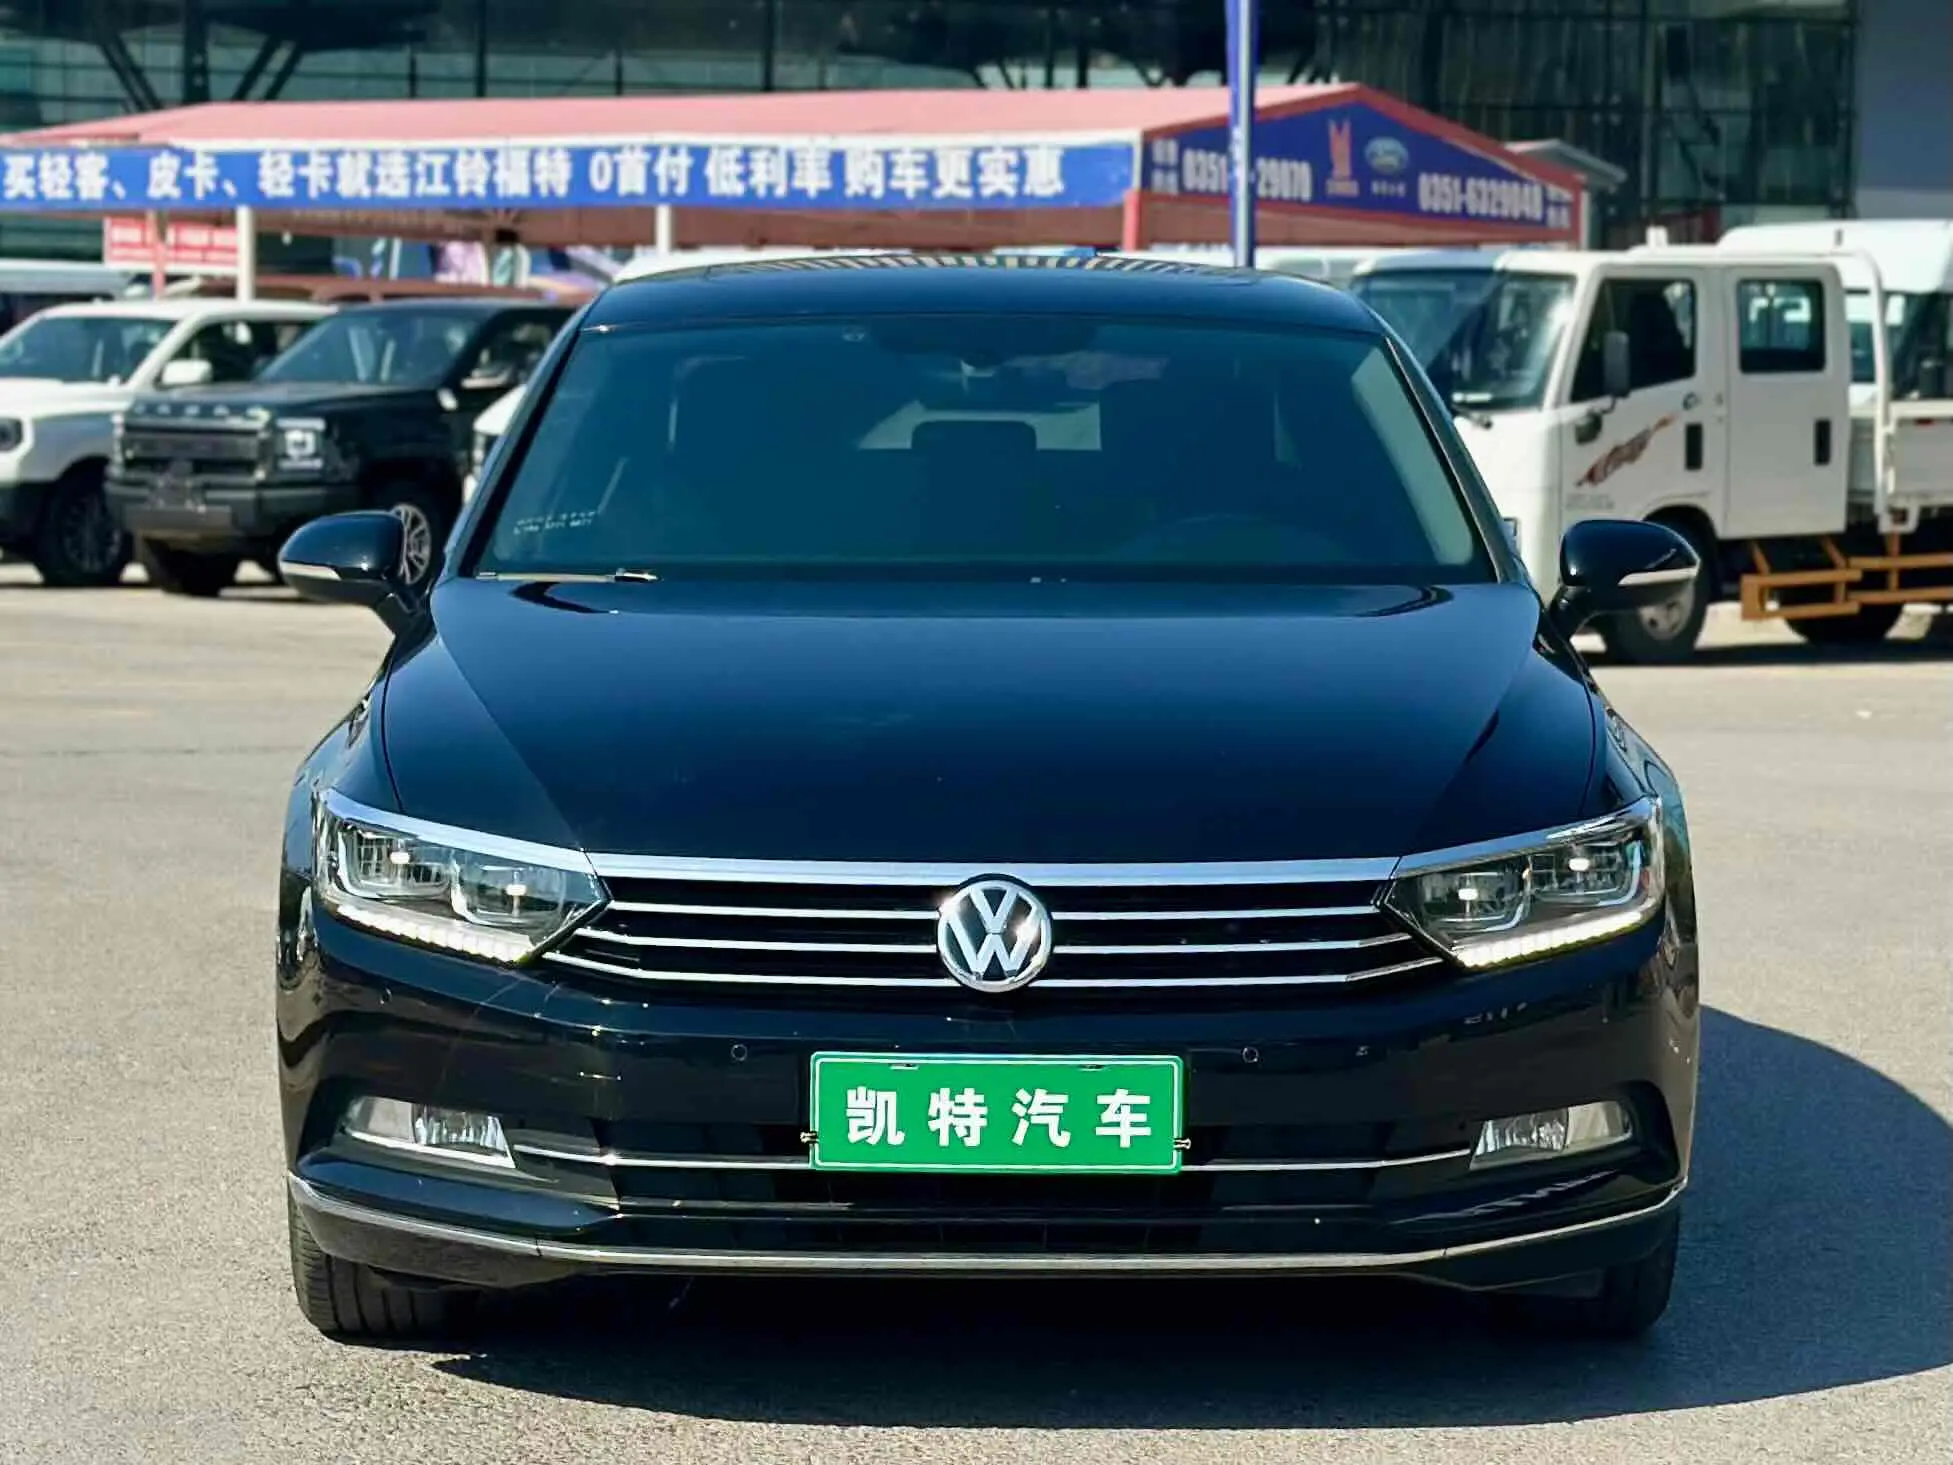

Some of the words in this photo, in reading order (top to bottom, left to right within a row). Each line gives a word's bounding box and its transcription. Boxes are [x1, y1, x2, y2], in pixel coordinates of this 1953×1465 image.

[588, 144, 694, 198] 0首付
[705, 145, 832, 198] 低利率
[844, 146, 1065, 198] 购车更实惠
[845, 1086, 1152, 1148] 凯特汽车
